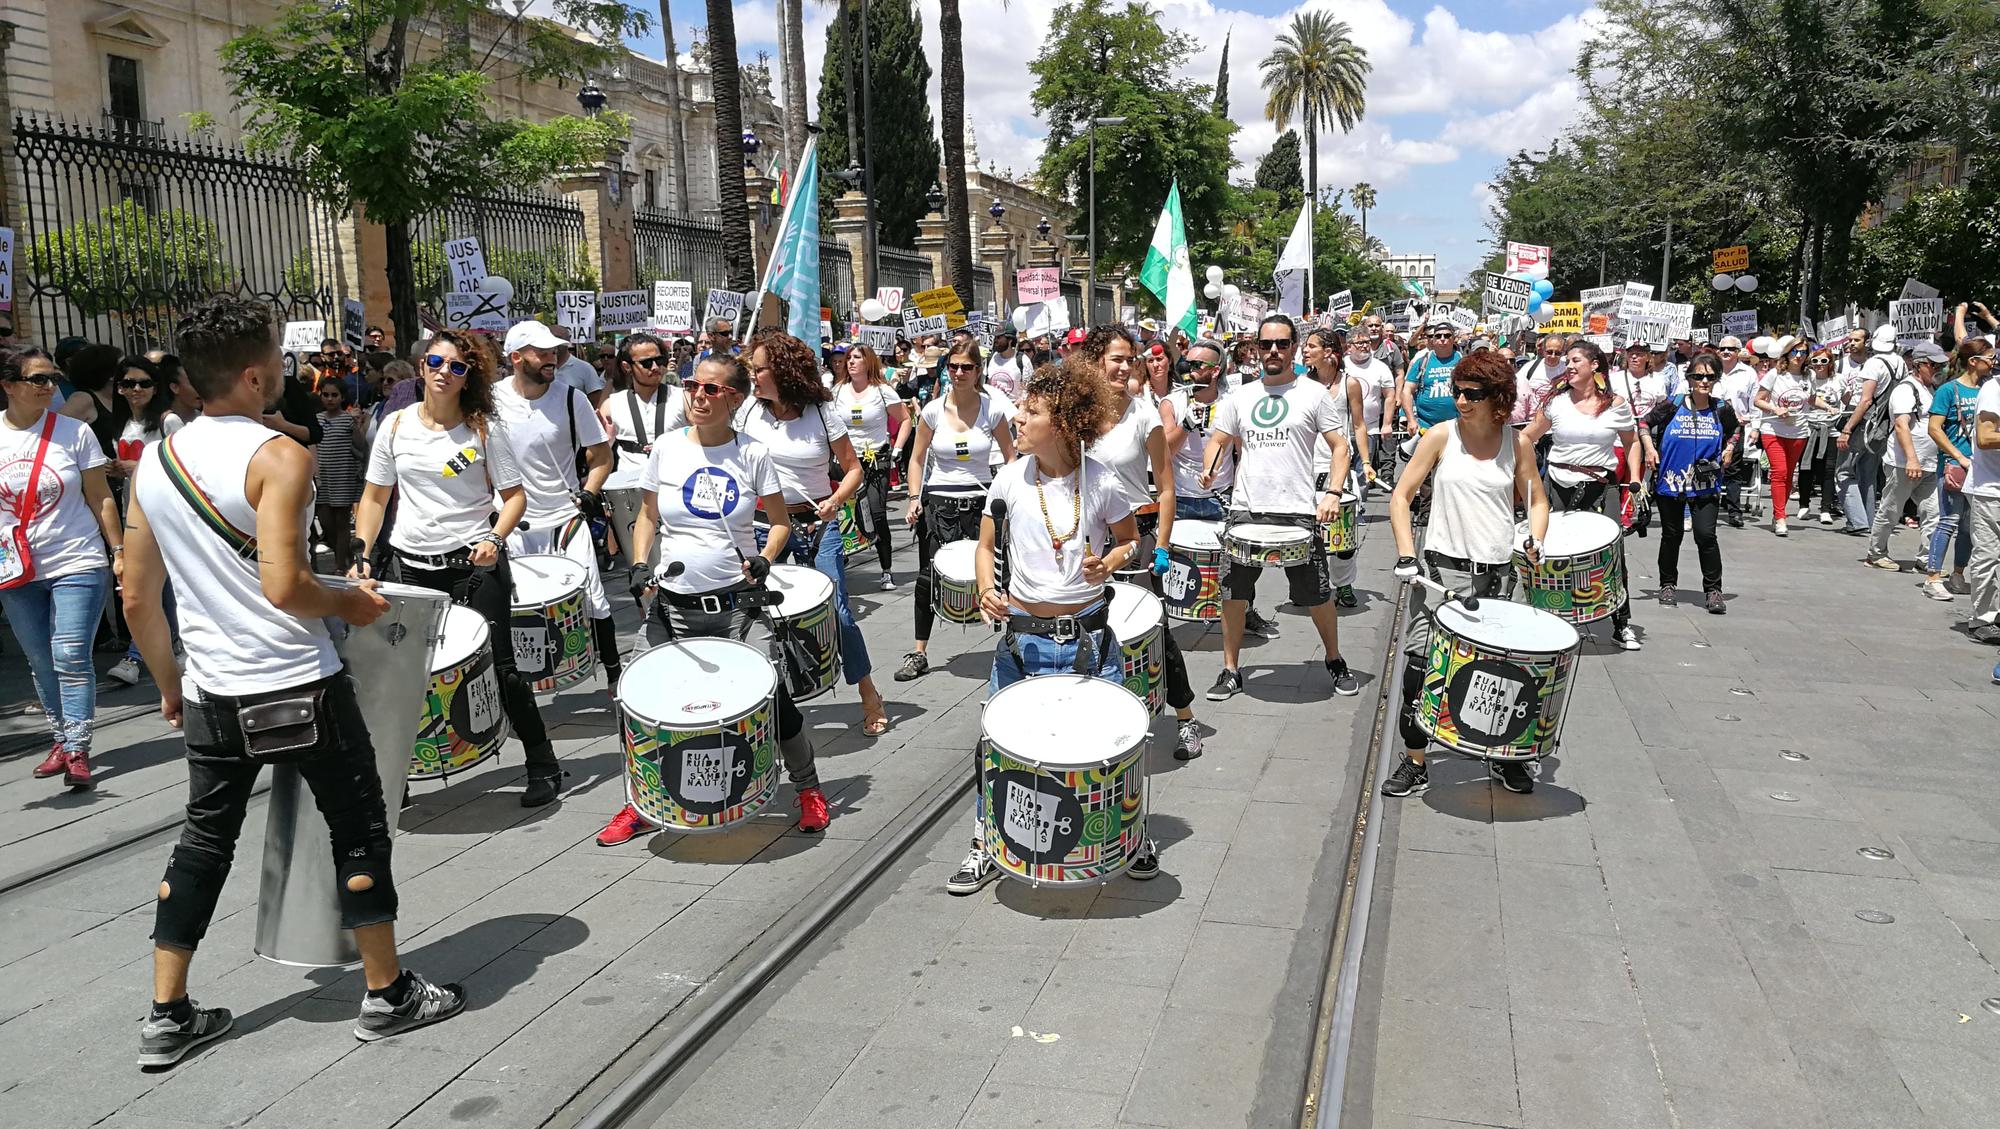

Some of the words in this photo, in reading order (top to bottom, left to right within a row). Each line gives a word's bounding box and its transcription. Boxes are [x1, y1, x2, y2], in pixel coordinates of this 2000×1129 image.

[449, 242, 479, 260] JUS-
[1738, 248, 1747, 256] la
[458, 260, 476, 276] TI-
[1714, 258, 1748, 269] SALUD!
[656, 286, 690, 297] RECORTES
[1487, 275, 1499, 289] SE
[1500, 278, 1531, 297] VENDE
[559, 295, 593, 308] JUS-
[601, 293, 647, 309] JUSTICIA
[710, 290, 741, 307] SUSANA
[1486, 289, 1497, 306] TU
[1496, 292, 1528, 312] SALUD
[656, 301, 664, 311] EN
[665, 301, 689, 312] SANIDAD
[708, 304, 738, 321] NO
[1895, 301, 1935, 316] VENDEN
[567, 311, 586, 324] TI-
[602, 313, 617, 326] PARA
[618, 312, 624, 324] LA
[625, 310, 646, 325] SANIDAD
[656, 315, 690, 326] MATAN.
[905, 310, 915, 320] SE
[908, 322, 918, 334] TU
[919, 317, 945, 332] SALUD.
[1539, 320, 1564, 329] SANA
[1891, 317, 1903, 333] MI
[1630, 321, 1669, 344] ¡JUSTICIA!
[1680, 422, 1713, 430] JUSICIA
[1246, 427, 1290, 443] Push!
[1260, 441, 1286, 449] Power
[1475, 675, 1497, 688] RUA
[687, 753, 710, 761] RUA
[687, 759, 720, 767] RUIDO
[1011, 785, 1032, 801] RUA
